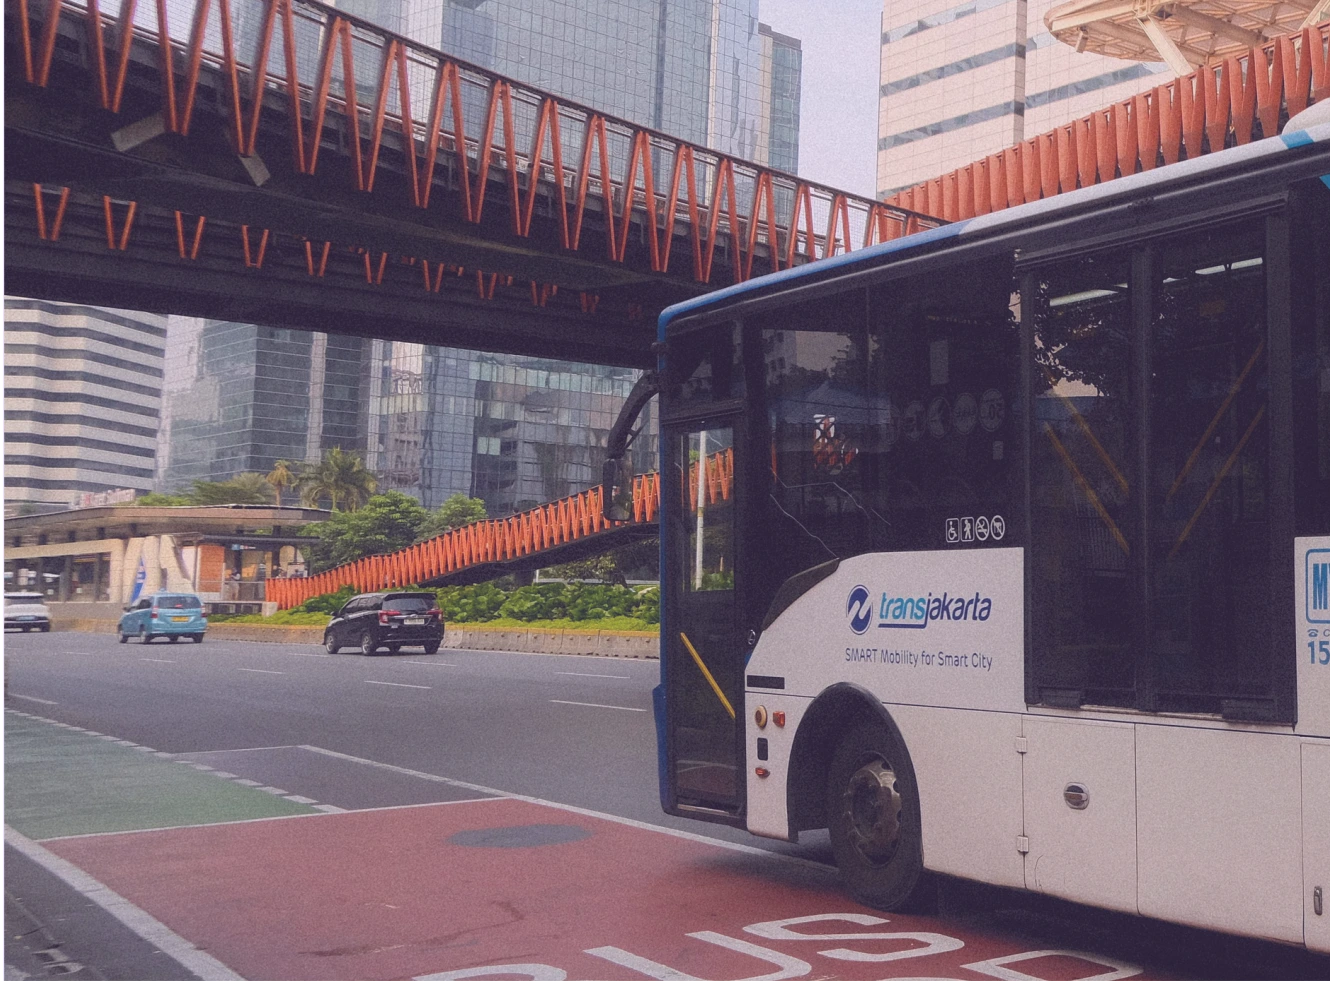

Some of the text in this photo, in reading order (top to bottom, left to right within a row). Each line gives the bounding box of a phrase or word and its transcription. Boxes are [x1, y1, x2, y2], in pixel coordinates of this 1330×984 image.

[877, 591, 993, 630] transjakarta
[845, 647, 993, 672] SMART Mobility for Smart City
